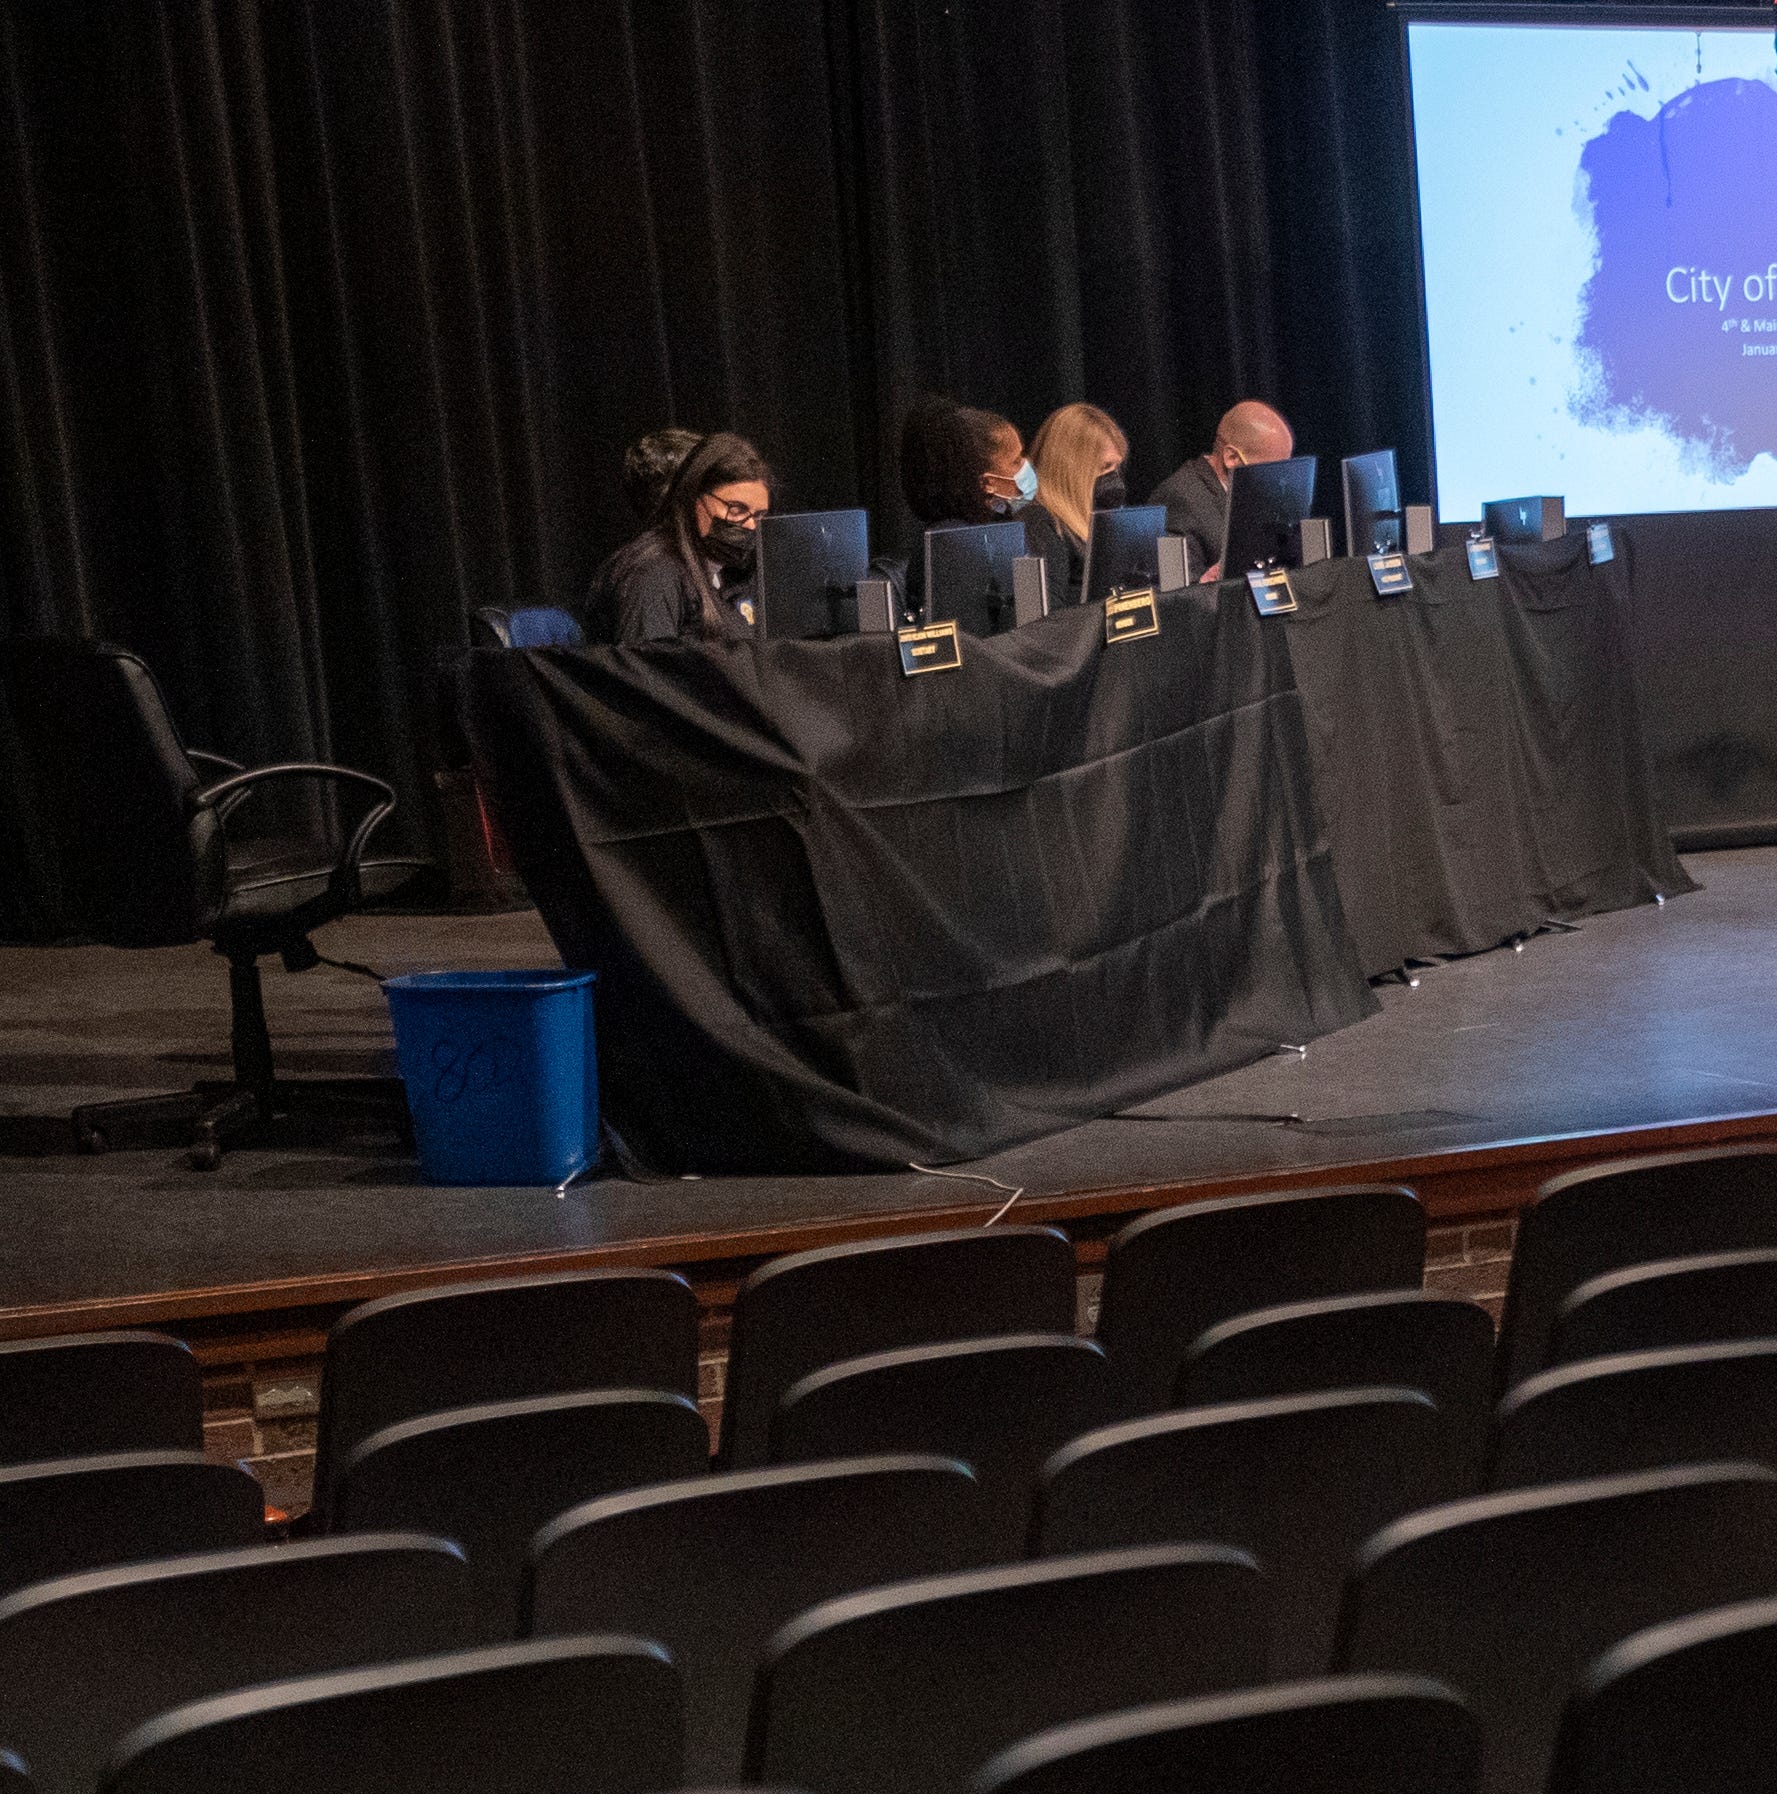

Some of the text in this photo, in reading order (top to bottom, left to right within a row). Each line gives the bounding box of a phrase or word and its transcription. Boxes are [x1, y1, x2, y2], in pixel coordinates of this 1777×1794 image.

[1665, 265, 1732, 312] City
[1721, 318, 1738, 333] 4th
[1740, 319, 1751, 333] &
